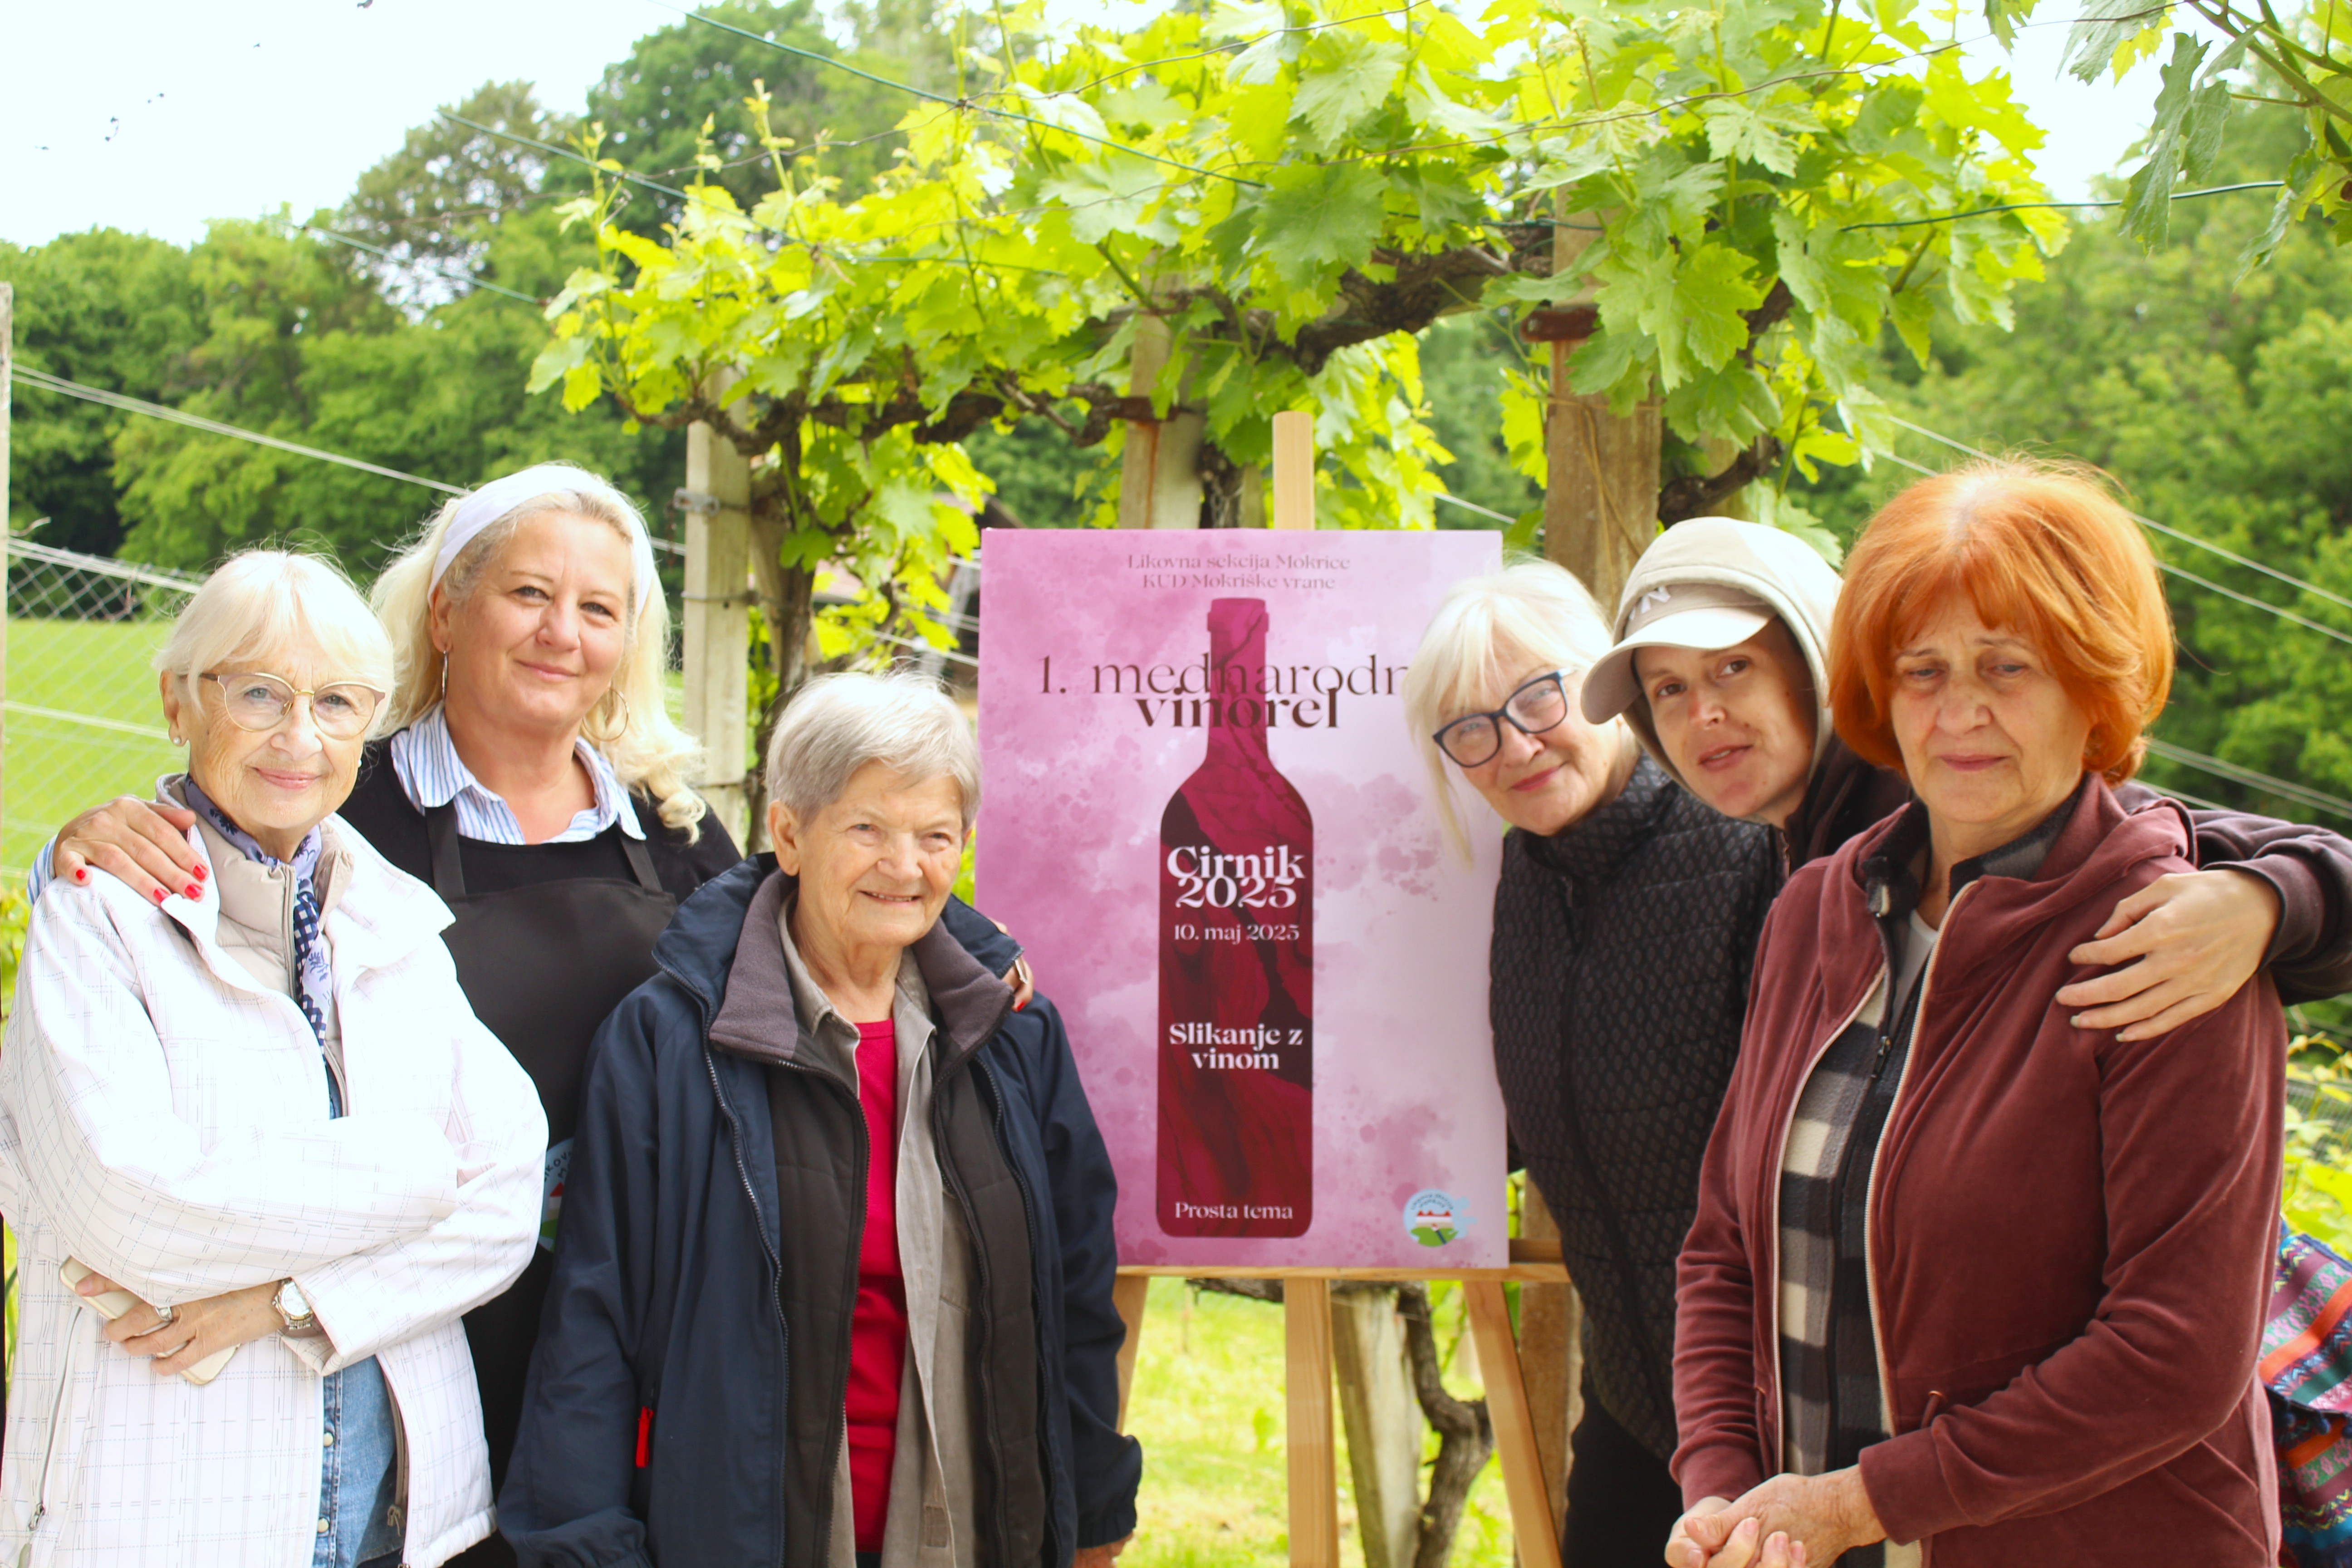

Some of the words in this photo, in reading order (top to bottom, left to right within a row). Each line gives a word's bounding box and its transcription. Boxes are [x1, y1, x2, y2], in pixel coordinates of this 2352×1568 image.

[1128, 554, 1201, 568] Likovna
[1206, 553, 1270, 572] sekcija
[1275, 554, 1351, 569] Mokrice
[1143, 573, 1187, 588] KUD
[1191, 573, 1278, 588] Mokriške
[1282, 577, 1336, 589] vrane
[1038, 655, 1066, 694] 1.
[1091, 652, 1409, 696] mednarodn
[1134, 685, 1339, 728] vinorel
[1166, 844, 1306, 879] Cirnik
[1175, 876, 1297, 908] 2025
[1174, 924, 1199, 941] 10.
[1204, 924, 1241, 945] maj
[1246, 924, 1300, 941] 2025
[1169, 1022, 1282, 1052] Slikanje
[1288, 1029, 1304, 1045] z
[1191, 1047, 1280, 1069] vinom
[1175, 1201, 1239, 1219] Prosta
[1243, 1204, 1294, 1220] tema
